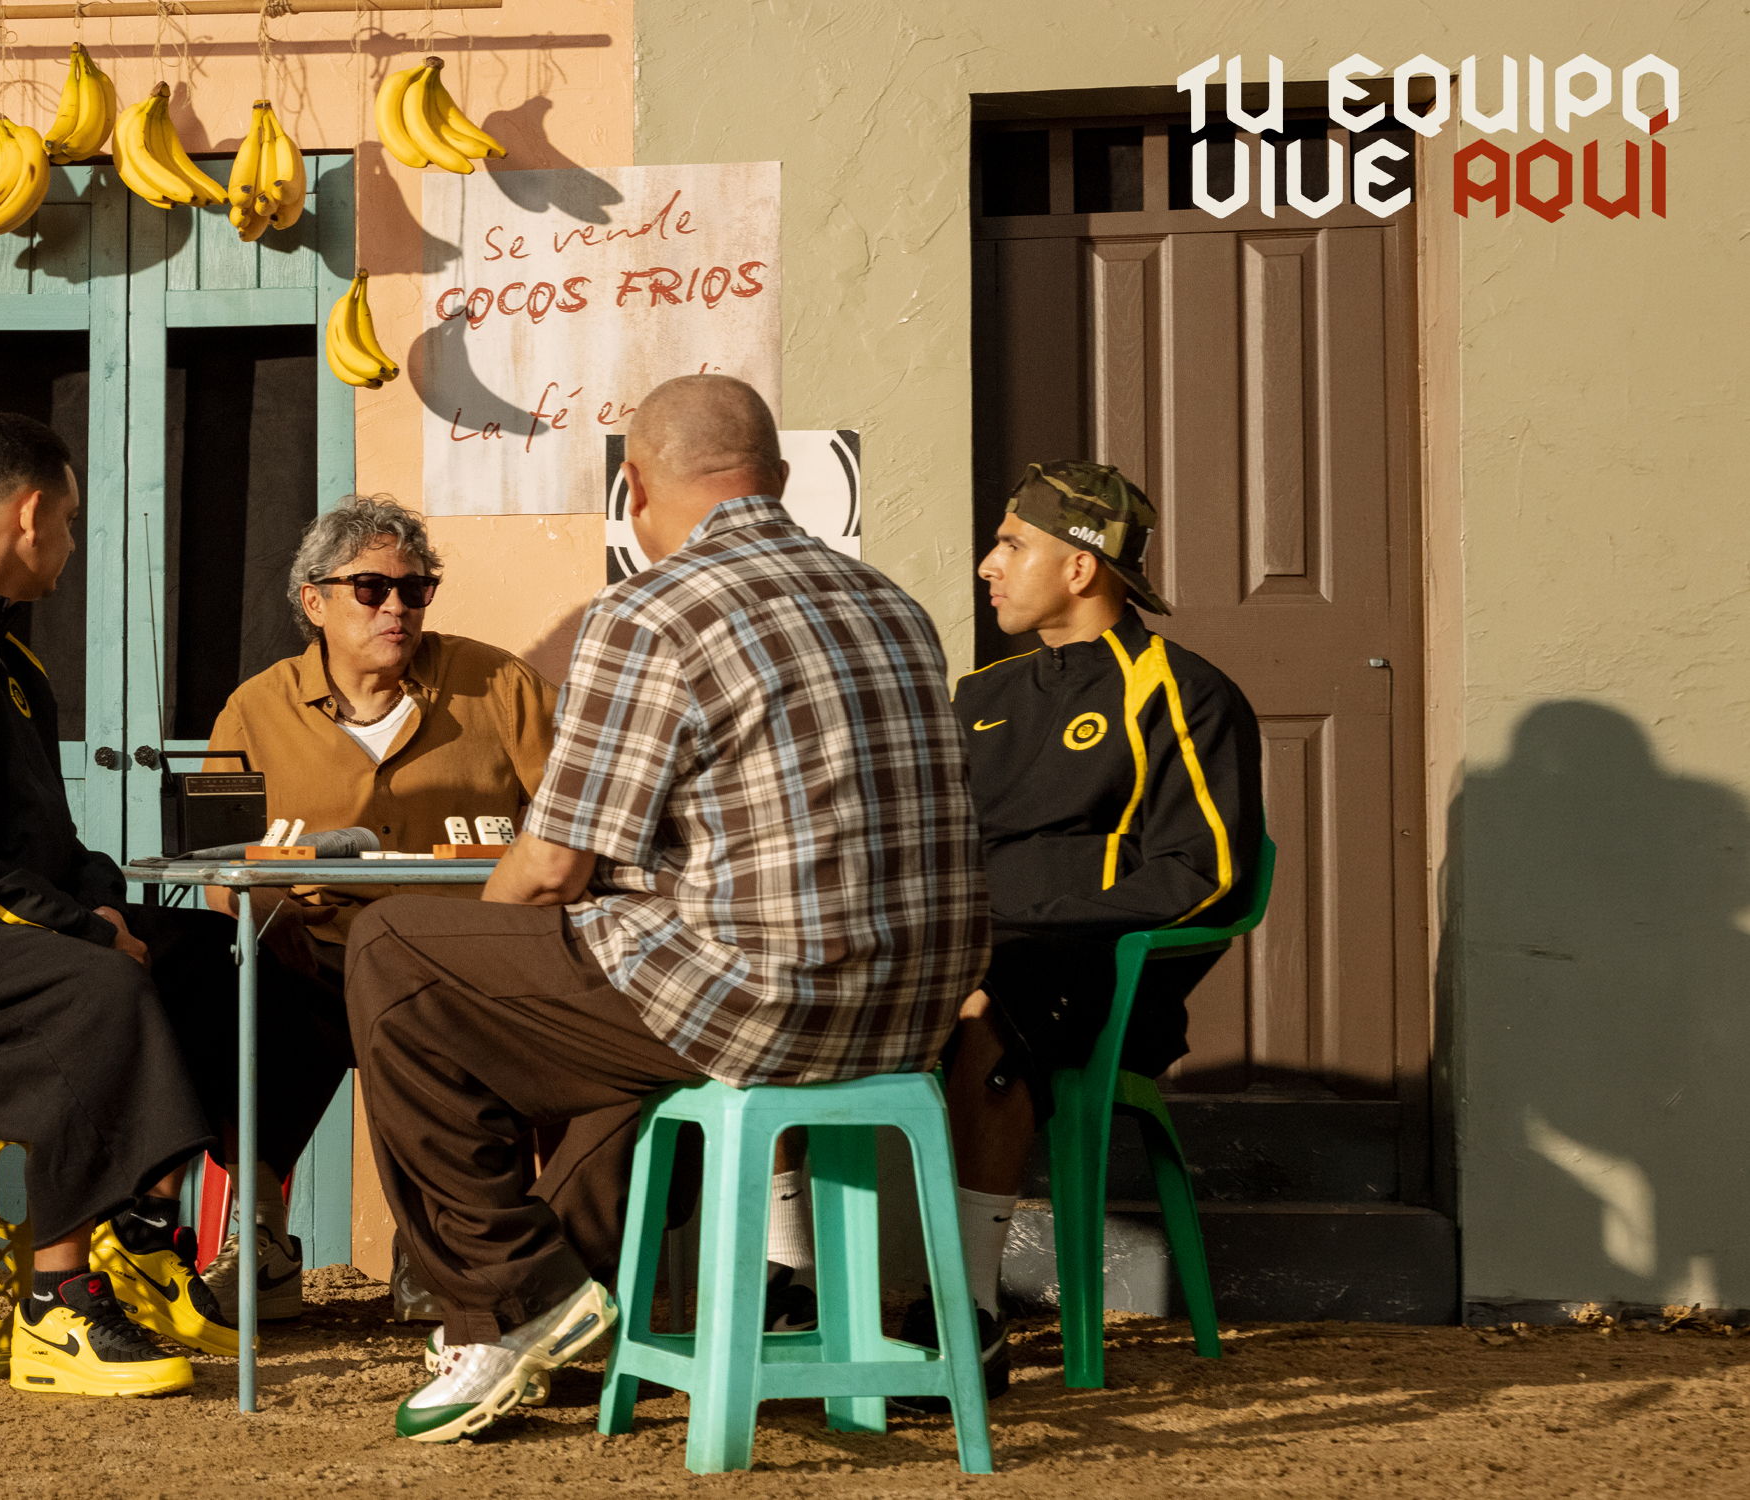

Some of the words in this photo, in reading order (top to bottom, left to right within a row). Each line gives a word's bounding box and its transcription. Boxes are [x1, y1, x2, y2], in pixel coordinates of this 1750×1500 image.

[483, 225, 531, 262] Se
[553, 189, 698, 253] vende
[435, 276, 593, 330] COCOS
[615, 261, 769, 310] FRIOS
[450, 407, 503, 442] La
[525, 381, 584, 453] fé
